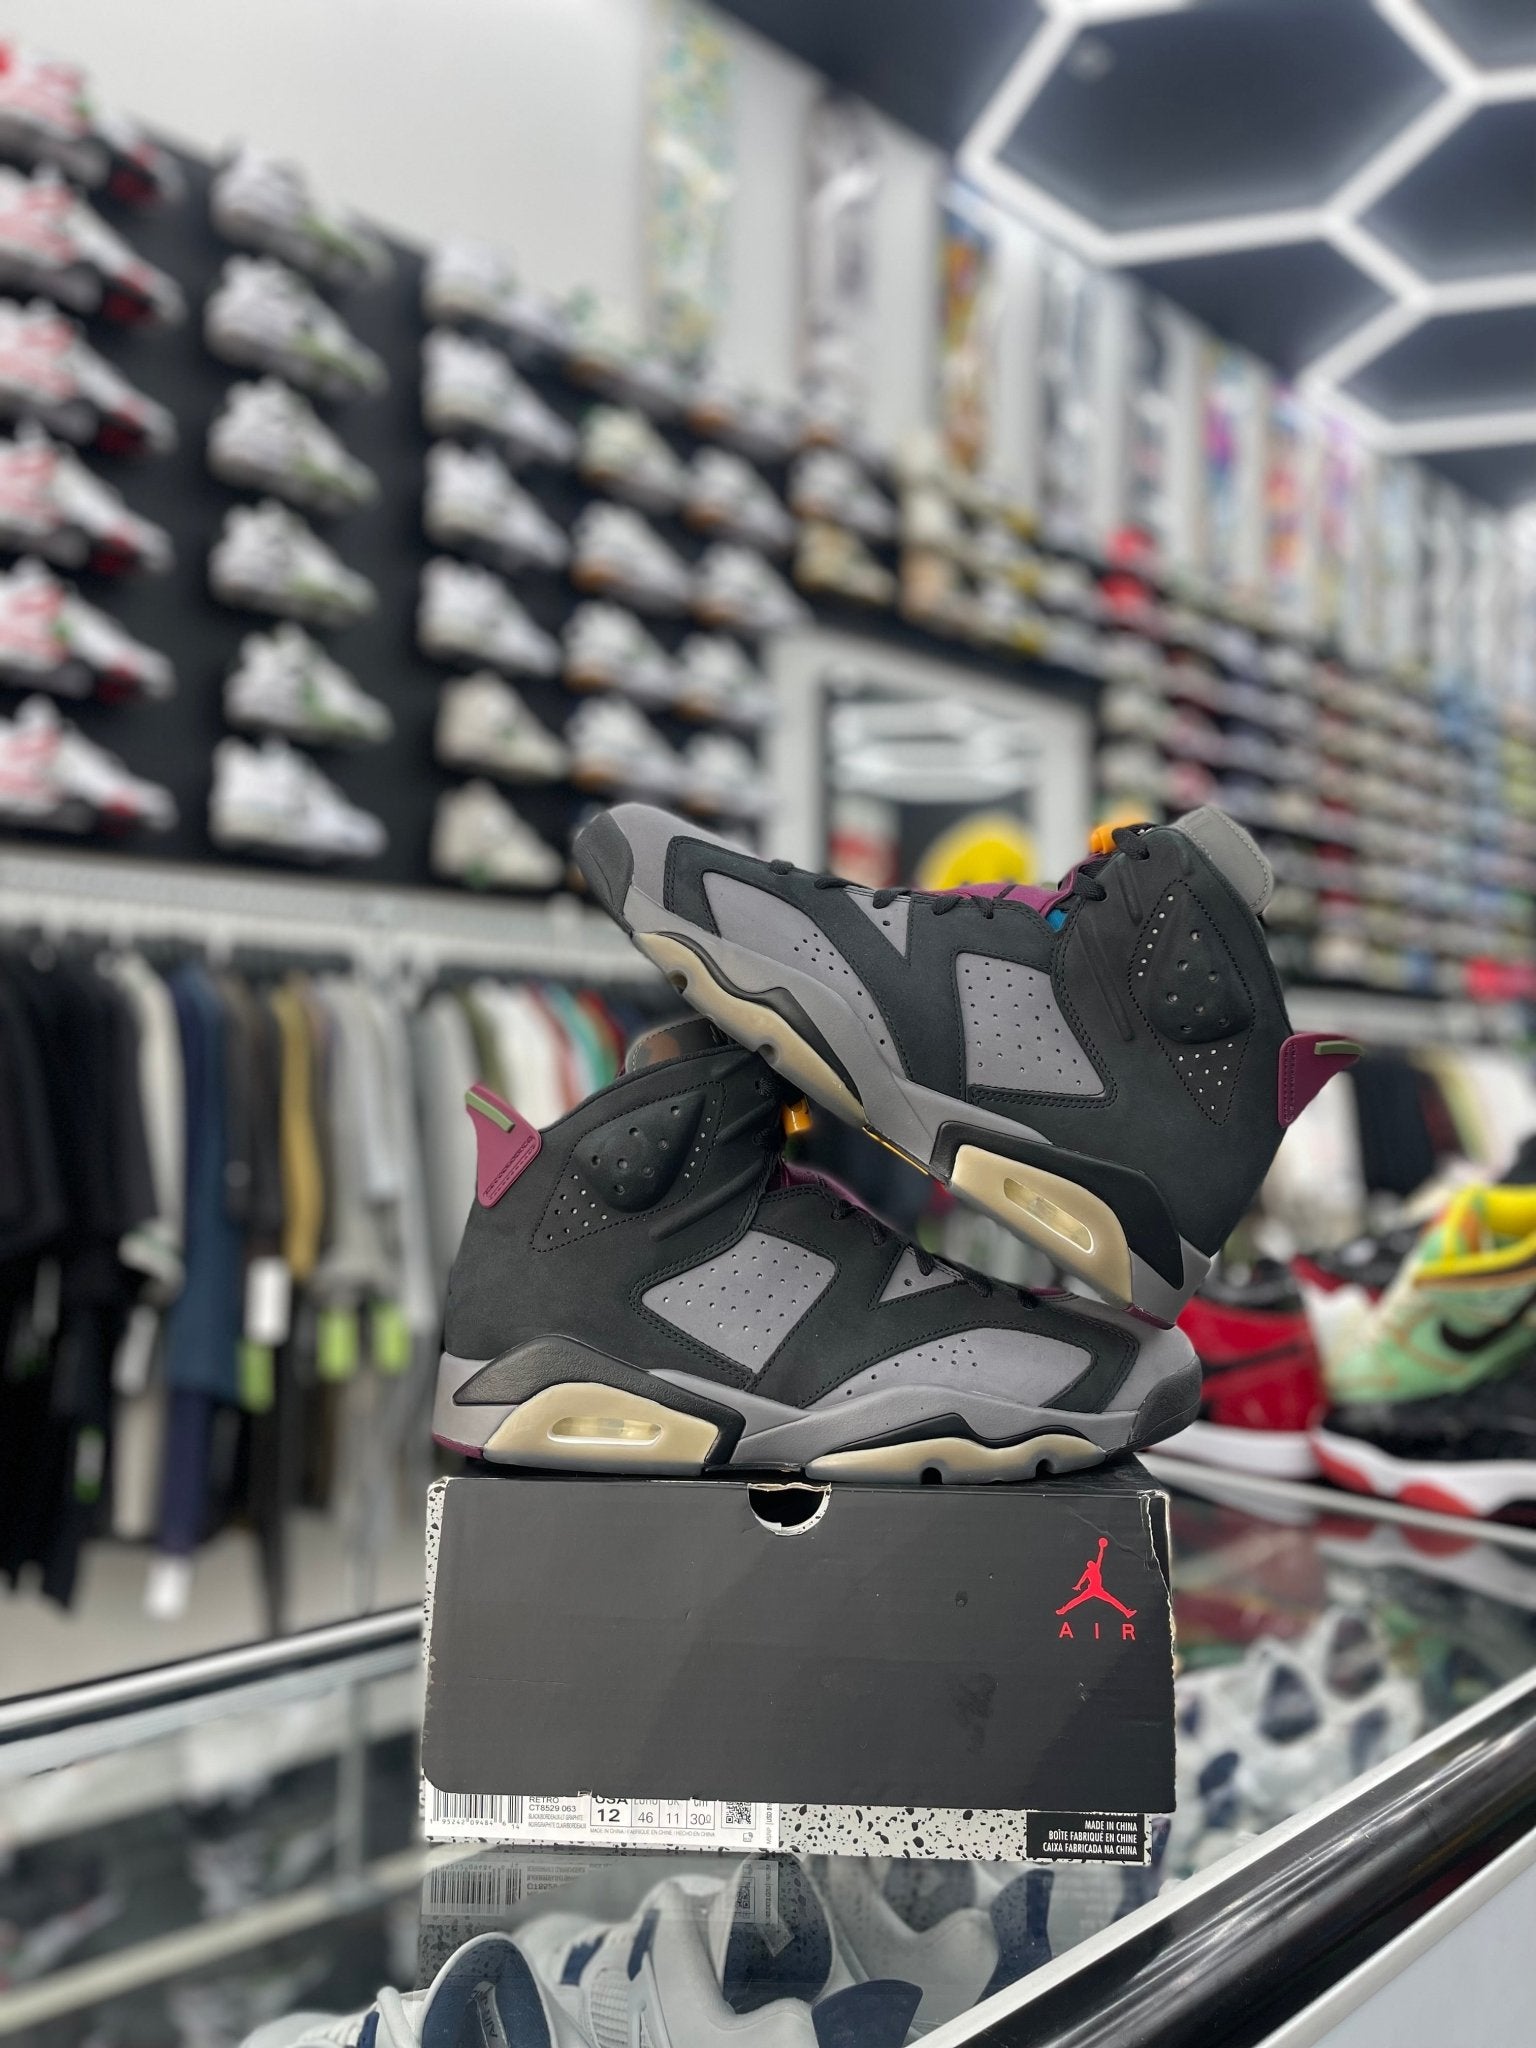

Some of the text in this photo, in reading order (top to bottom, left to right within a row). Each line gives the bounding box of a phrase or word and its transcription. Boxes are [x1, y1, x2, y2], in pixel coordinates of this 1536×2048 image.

[1058, 1621, 1136, 1641] AIR
[528, 1796, 560, 1804] RETRO
[528, 1804, 560, 1812] CT8529
[597, 1808, 620, 1822] 12
[638, 1812, 654, 1823] 46
[667, 1813, 680, 1824] 11
[1085, 1820, 1138, 1832] MADE IN CHINA
[1048, 1829, 1068, 1840] BOÎTE
[1105, 1833, 1115, 1843] EN
[1116, 1833, 1138, 1844] CHINE
[1043, 1842, 1138, 1856] CAIXA FABRICADA NA CHINA
